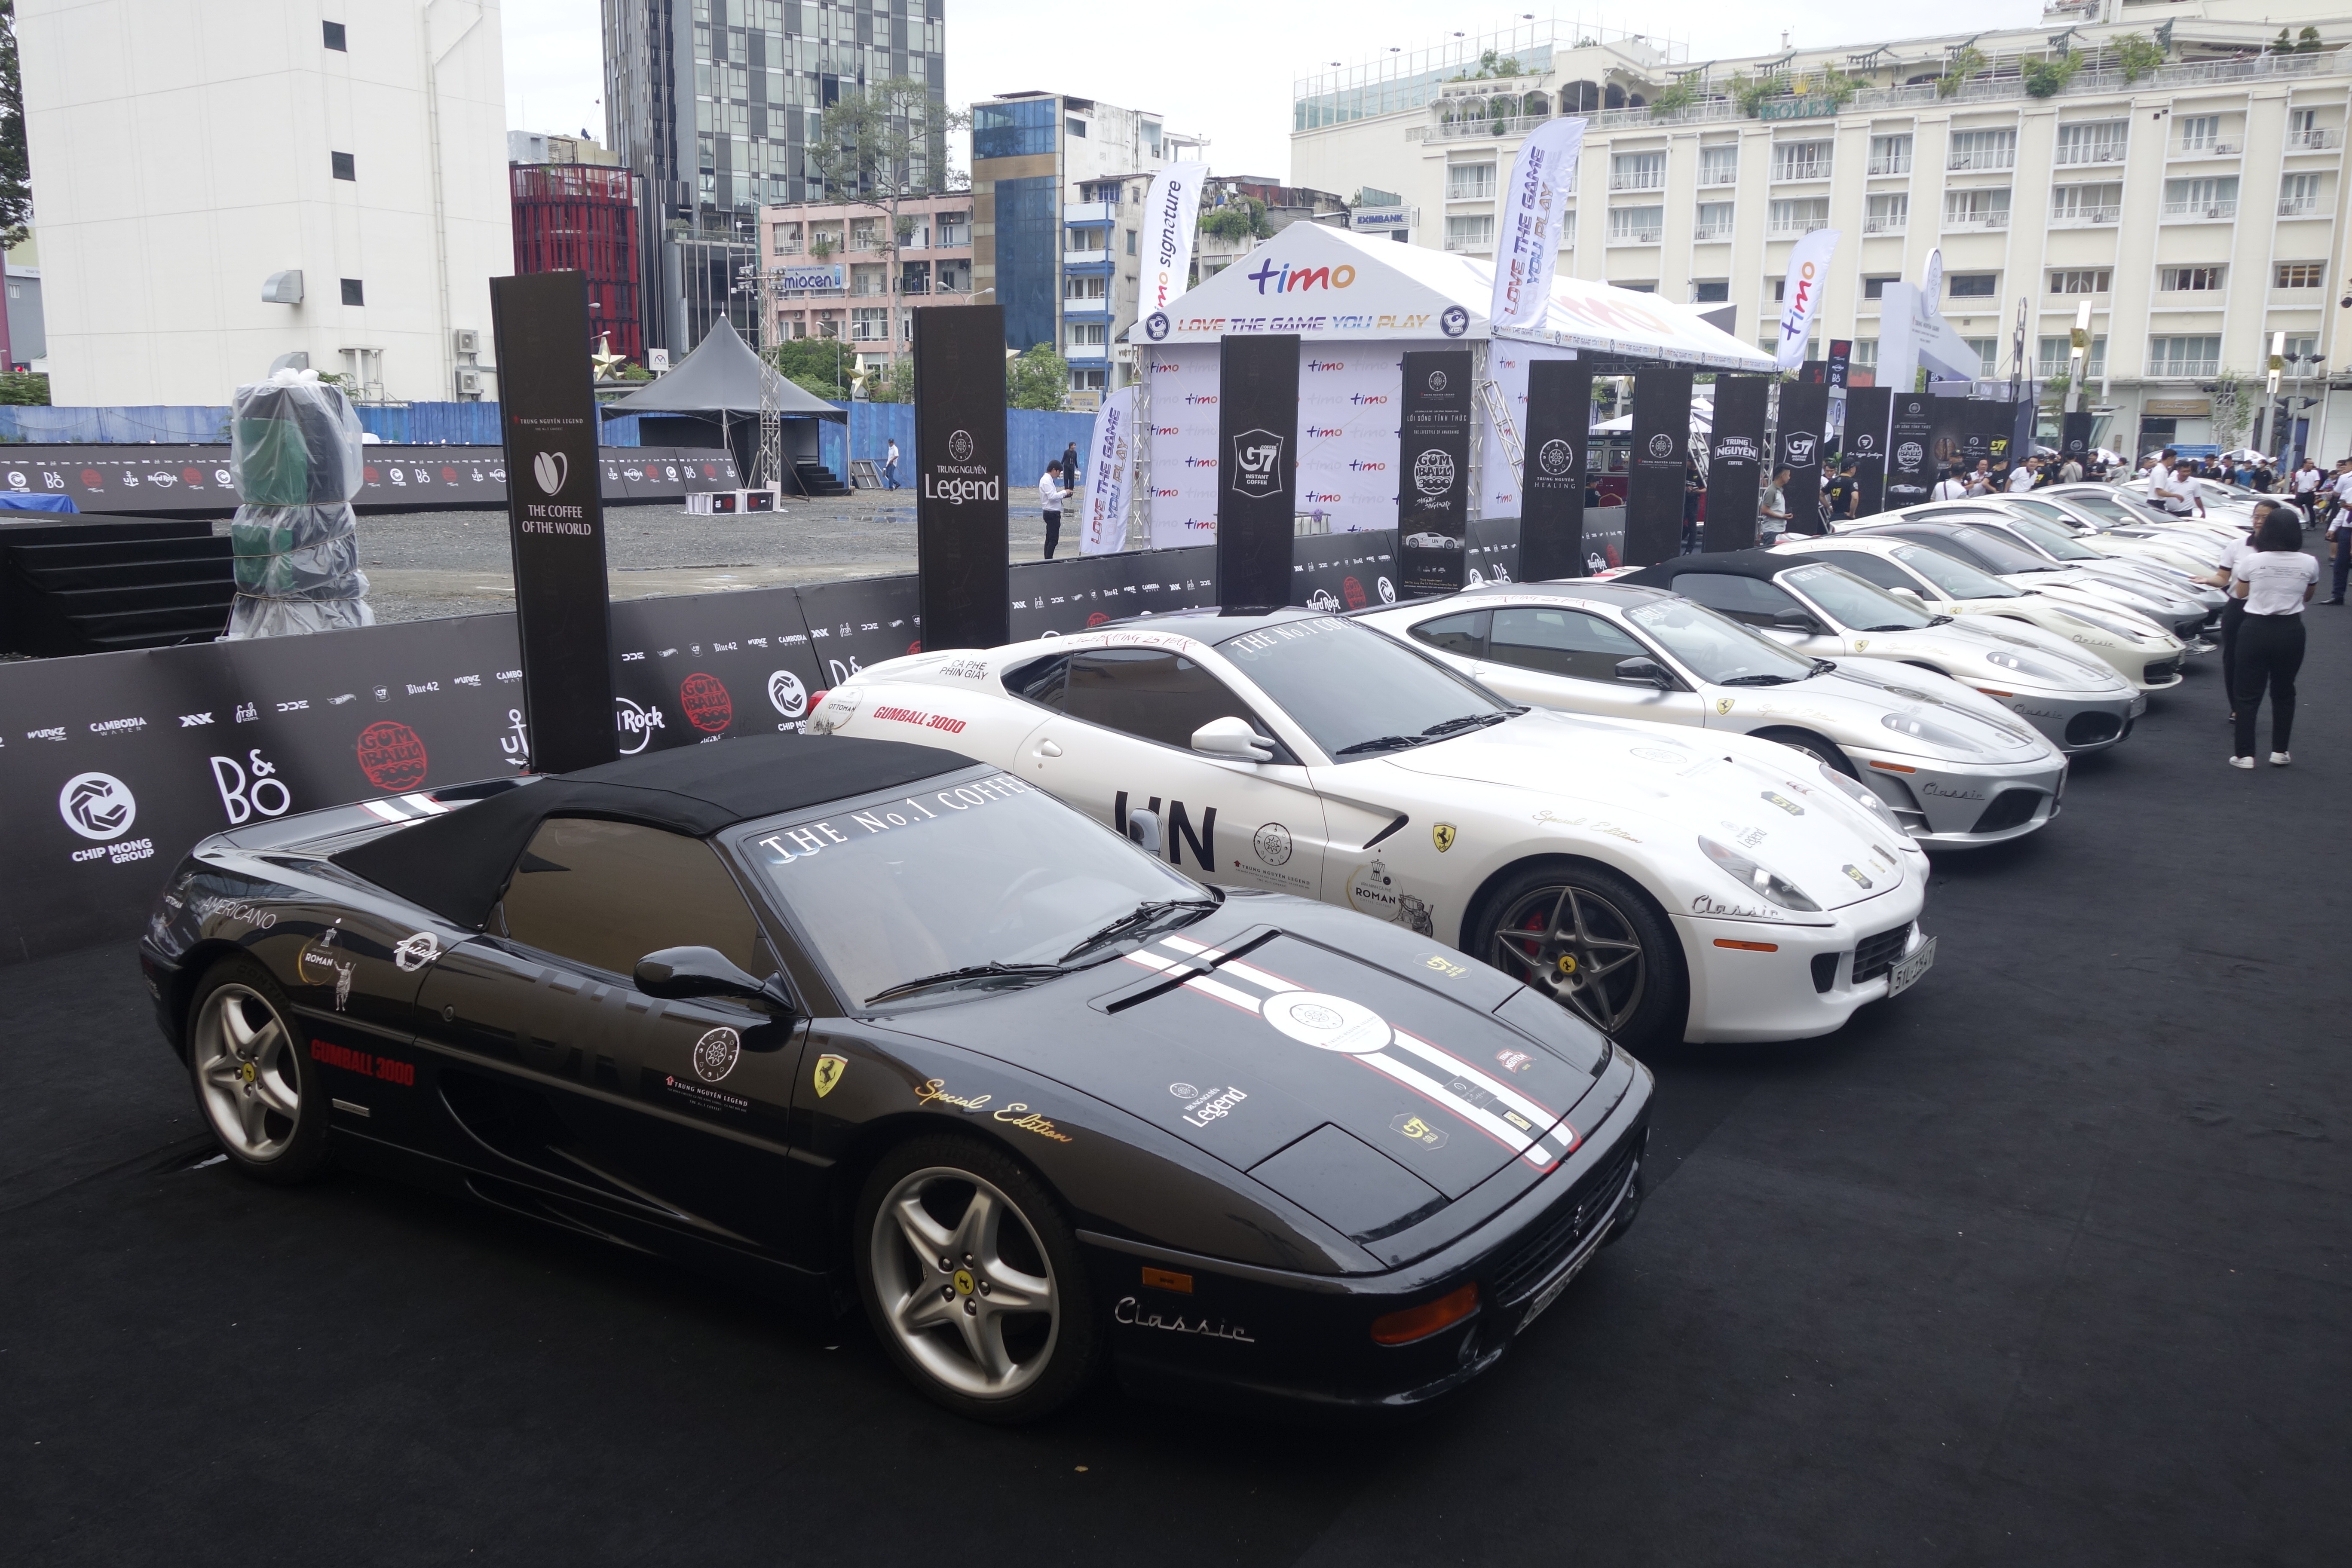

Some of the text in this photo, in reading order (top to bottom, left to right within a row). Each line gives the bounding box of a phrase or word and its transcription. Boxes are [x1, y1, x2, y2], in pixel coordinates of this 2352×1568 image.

[1160, 180, 1181, 268] signature
[1357, 214, 1403, 224] EXIMBANK
[1504, 145, 1545, 315] LOVE THE GAME
[1526, 181, 1553, 284] YOU PLAY
[784, 272, 832, 288] miocen
[1248, 258, 1356, 295] timo
[1782, 261, 1816, 341] timo
[1178, 314, 1431, 333] LOVE THE GAME YOU PLAY
[1118, 349, 1131, 358] VIỆT
[1150, 361, 1179, 373] timo
[1308, 359, 1344, 372] timo
[1500, 356, 1516, 369] timo
[1185, 393, 1218, 404] timo
[1351, 392, 1387, 405] timo
[1150, 424, 1179, 435] timo
[1307, 426, 1342, 438] timo
[1717, 446, 1756, 458] NGUYÊN
[1788, 440, 1813, 455] G7
[1185, 455, 1217, 468] timo
[1239, 446, 1277, 472] G7
[1349, 459, 1386, 472] timo
[1417, 453, 1452, 466] GUM
[937, 464, 987, 474] TRUNG NGUYÊN
[1091, 407, 1121, 544] LOVE THE GAME
[1416, 466, 1453, 479] BALL
[1107, 436, 1128, 519] YOU PLAY
[925, 473, 999, 505] Legend
[1150, 486, 1178, 498] timo
[1305, 490, 1341, 502] timo
[1496, 492, 1512, 505] timo
[528, 504, 583, 518] THE COFFEE
[522, 521, 591, 536] OF THE WORLD
[1185, 517, 1216, 530] timo
[1306, 596, 1341, 611] Hard Rock
[778, 634, 807, 643] CAMBODIA
[1068, 634, 1141, 646] CELEBRATING
[1230, 621, 1319, 654] THE No.1
[2072, 634, 2116, 648] Classic
[939, 667, 963, 677] PHIN
[951, 659, 988, 671] CÀ PHÊ
[454, 675, 481, 684] WURKZ
[828, 703, 857, 712] OTTOMAN
[2012, 703, 2064, 720] Classic
[90, 717, 147, 732] CAMBODIA
[622, 706, 665, 733] Rock
[778, 722, 795, 731] CHIP
[873, 705, 967, 734] GUMBALL 3000
[27, 727, 66, 739] WURKZ
[100, 726, 142, 736] WATER
[1922, 782, 1985, 801] Classic
[758, 775, 1037, 860] THE No.1 COFFEE
[1532, 810, 1644, 844] Special Edition
[1737, 827, 1768, 849] Legend
[71, 838, 153, 862] CHIP MONG
[112, 848, 155, 864] GROUP
[1242, 864, 1261, 873] TRUNG
[1263, 870, 1286, 879] NGUYÊN
[1288, 876, 1310, 885] LEGEND
[1356, 887, 1396, 904] ROMAN
[200, 896, 276, 929] AMERICANO
[1691, 894, 1784, 921] Classic
[393, 940, 442, 961] Success
[305, 953, 334, 967] ROMAN
[310, 1038, 415, 1087] GUMBALL 3000
[1499, 1050, 1513, 1061] TRUNG
[1504, 1053, 1528, 1070] NGUYÊN
[674, 1081, 695, 1092] TRUNG
[697, 1088, 722, 1099] NGUYÊN
[723, 1095, 748, 1107] LEGEND
[915, 1078, 1073, 1143] Special Edition
[1182, 1086, 1248, 1128] Legend
[1184, 1096, 1203, 1112] TRUNG
[1422, 1132, 1438, 1144] GOLD
[1115, 1295, 1255, 1344] Classic
